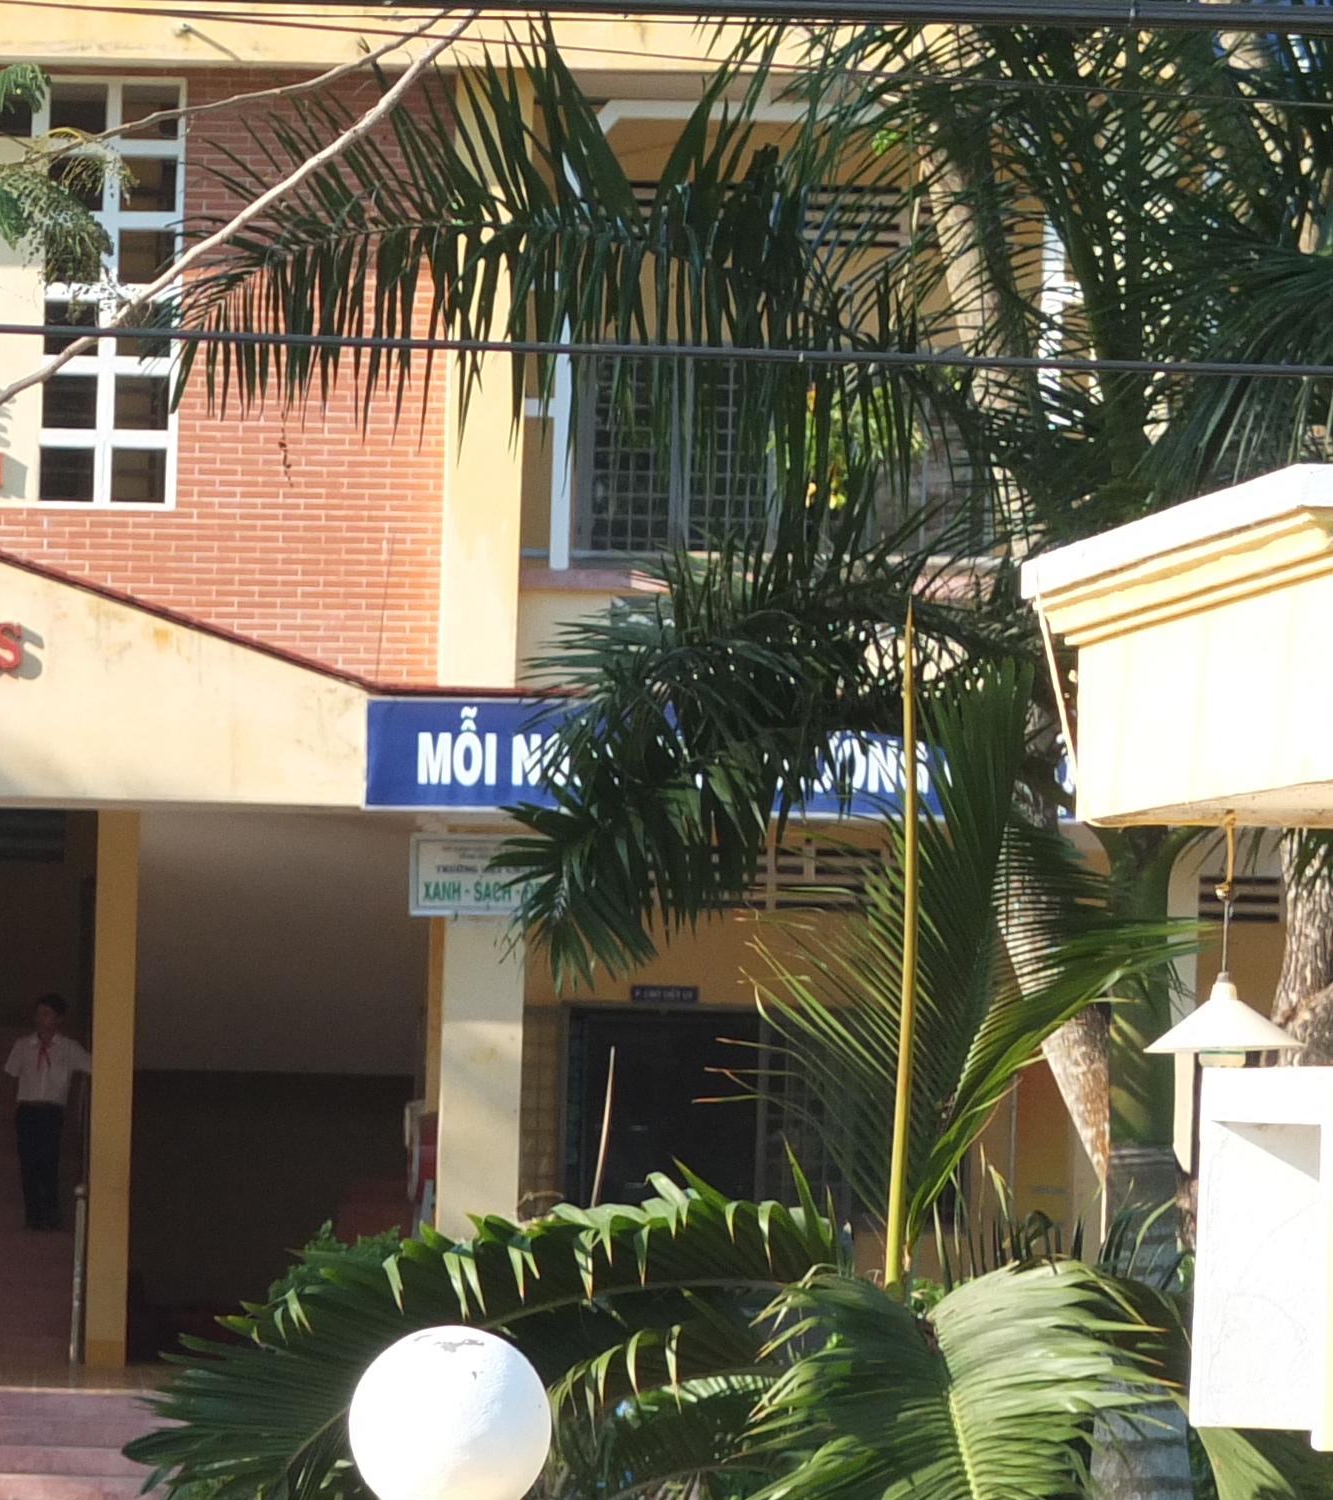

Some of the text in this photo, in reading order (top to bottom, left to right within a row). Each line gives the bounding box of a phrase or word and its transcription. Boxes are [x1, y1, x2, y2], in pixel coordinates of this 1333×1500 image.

[416, 706, 498, 787] MỖI
[422, 881, 462, 901] XANH
[473, 880, 512, 909] SẠCH
